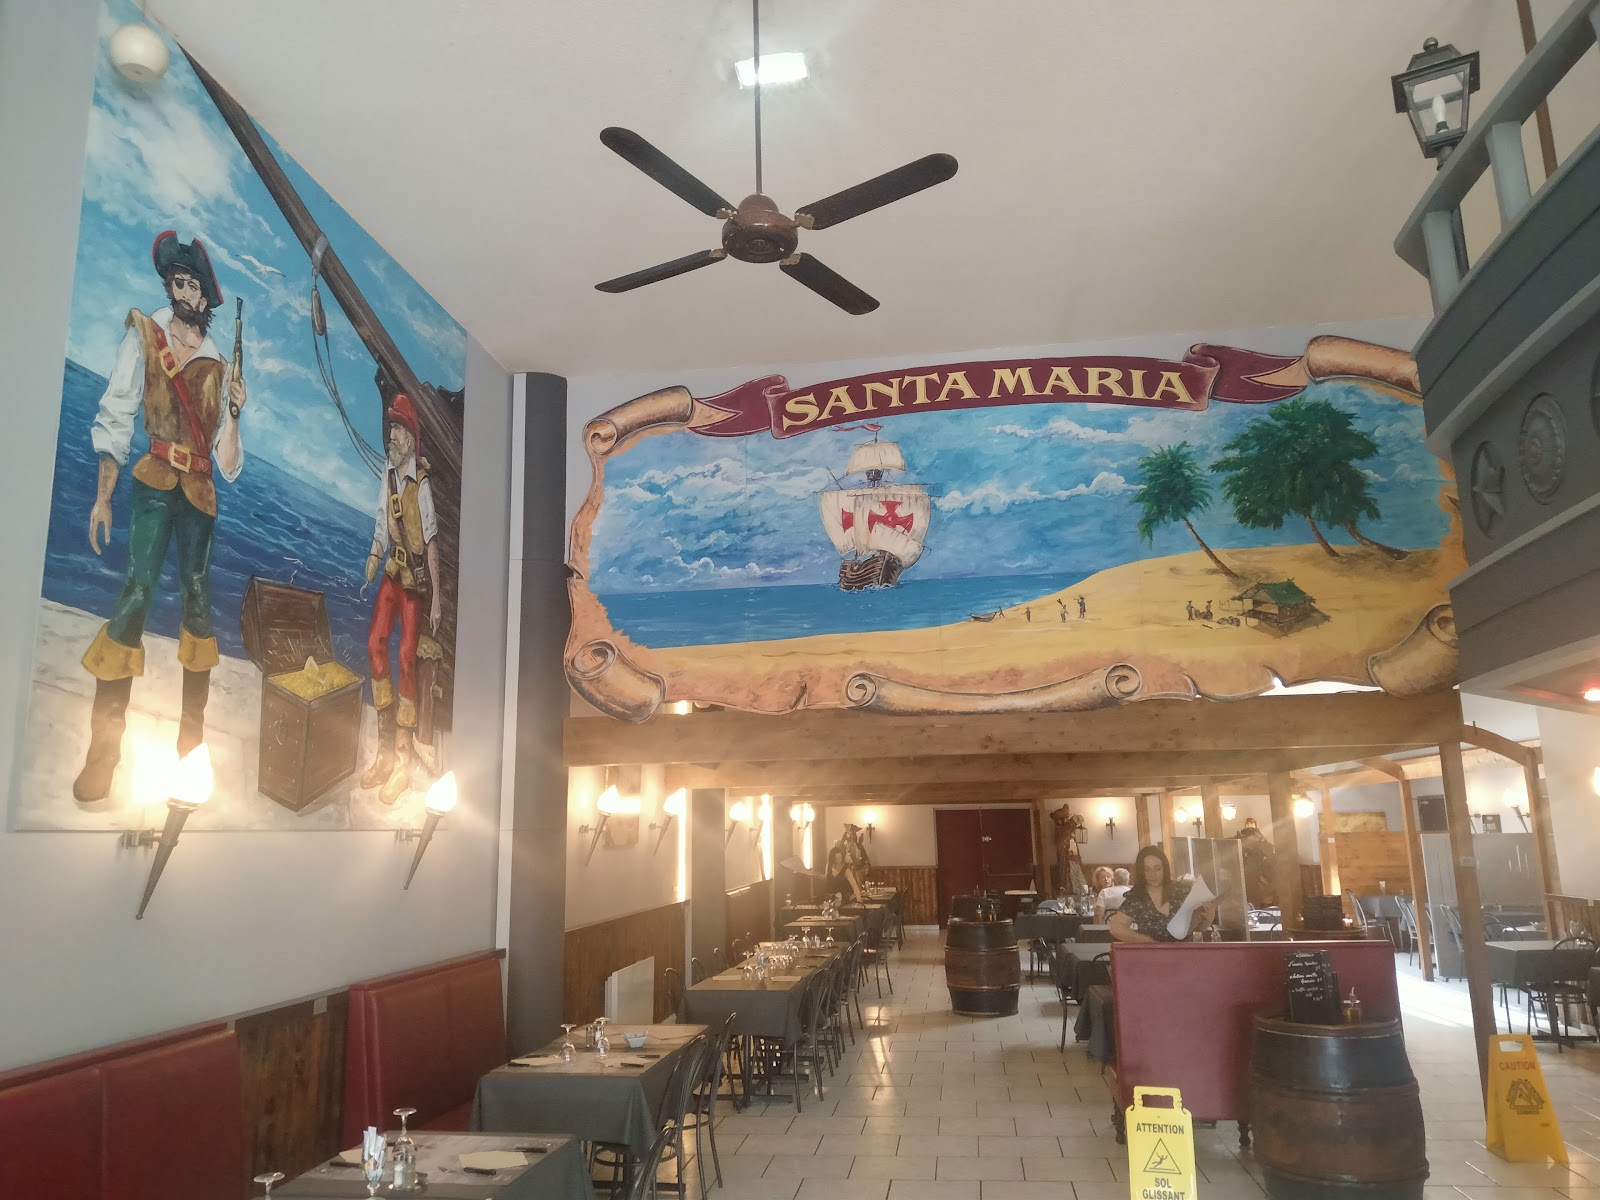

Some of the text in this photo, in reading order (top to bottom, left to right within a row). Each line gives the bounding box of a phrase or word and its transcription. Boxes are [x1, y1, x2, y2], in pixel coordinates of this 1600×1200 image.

[783, 366, 1199, 431] SANTA MARIA
[1500, 1061, 1536, 1071] CAUTION
[1136, 1123, 1184, 1135] ATTENTION
[1155, 1178, 1171, 1188] SOL
[1142, 1189, 1185, 1200] GLISSANT
